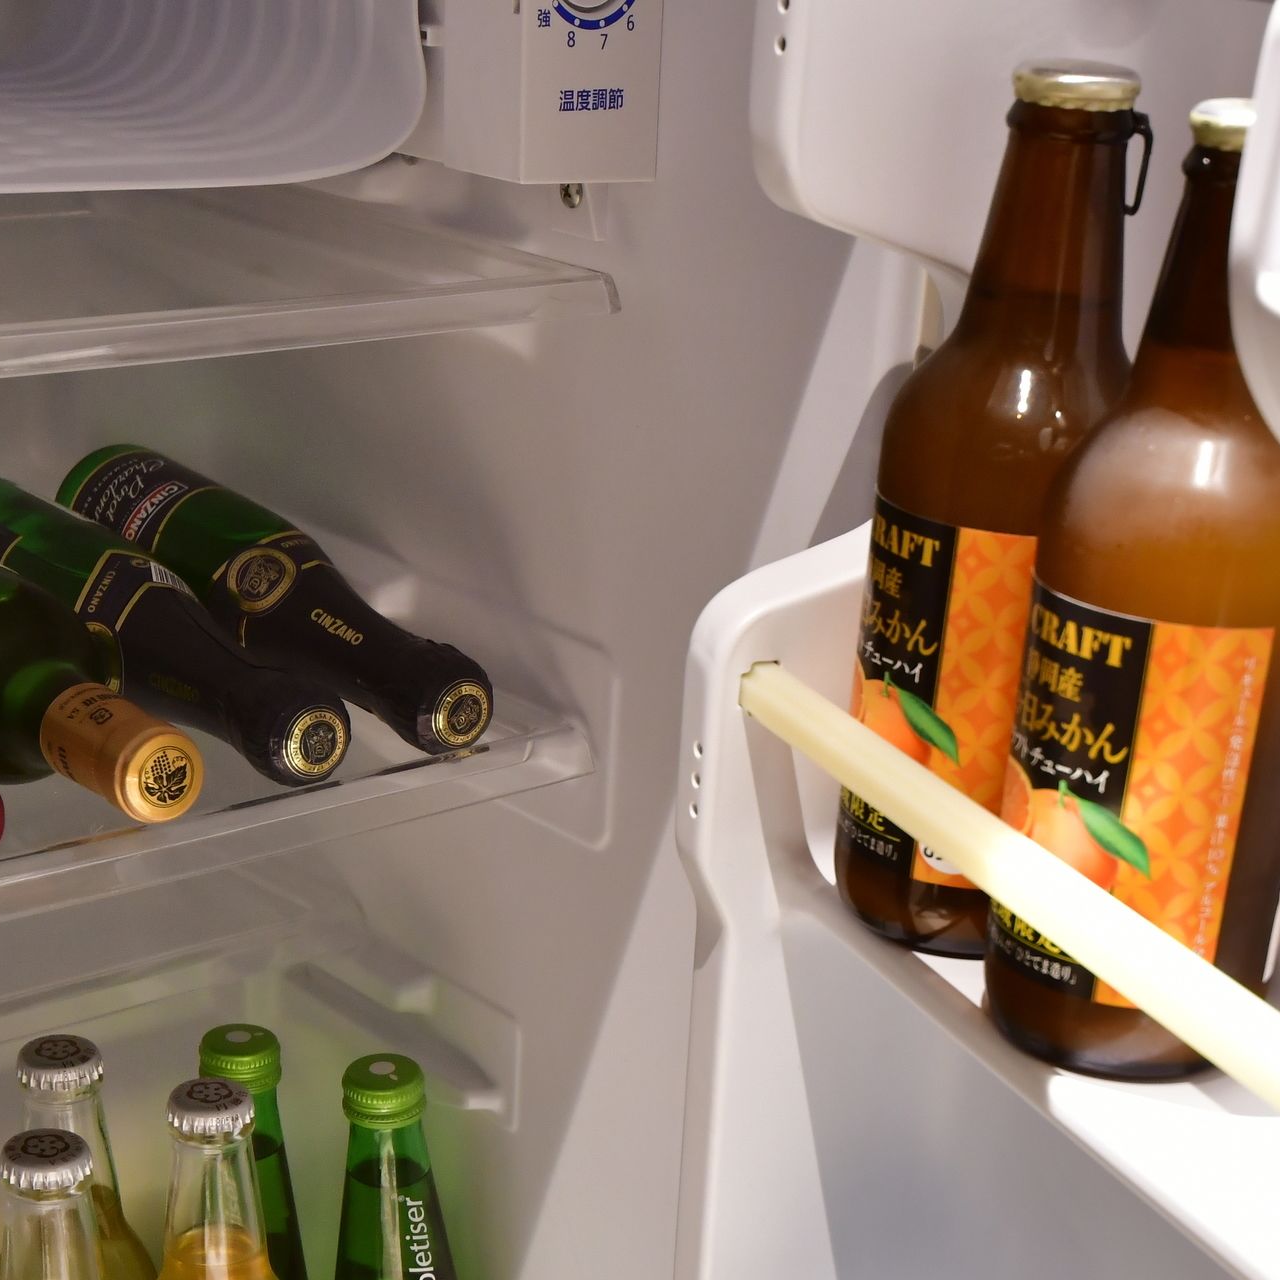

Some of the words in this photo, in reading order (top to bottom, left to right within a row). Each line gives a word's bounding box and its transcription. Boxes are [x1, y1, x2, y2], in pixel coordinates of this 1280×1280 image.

[537, 9, 551, 28] 強
[626, 14, 635, 31] 6
[567, 31, 576, 48] 8
[600, 33, 608, 50] 7
[559, 88, 624, 112] 温度調節
[124, 485, 180, 542] CINZANO
[87, 570, 117, 613] CINZANO
[310, 608, 365, 647] CINZANO
[1031, 602, 1133, 669] CRAFT
